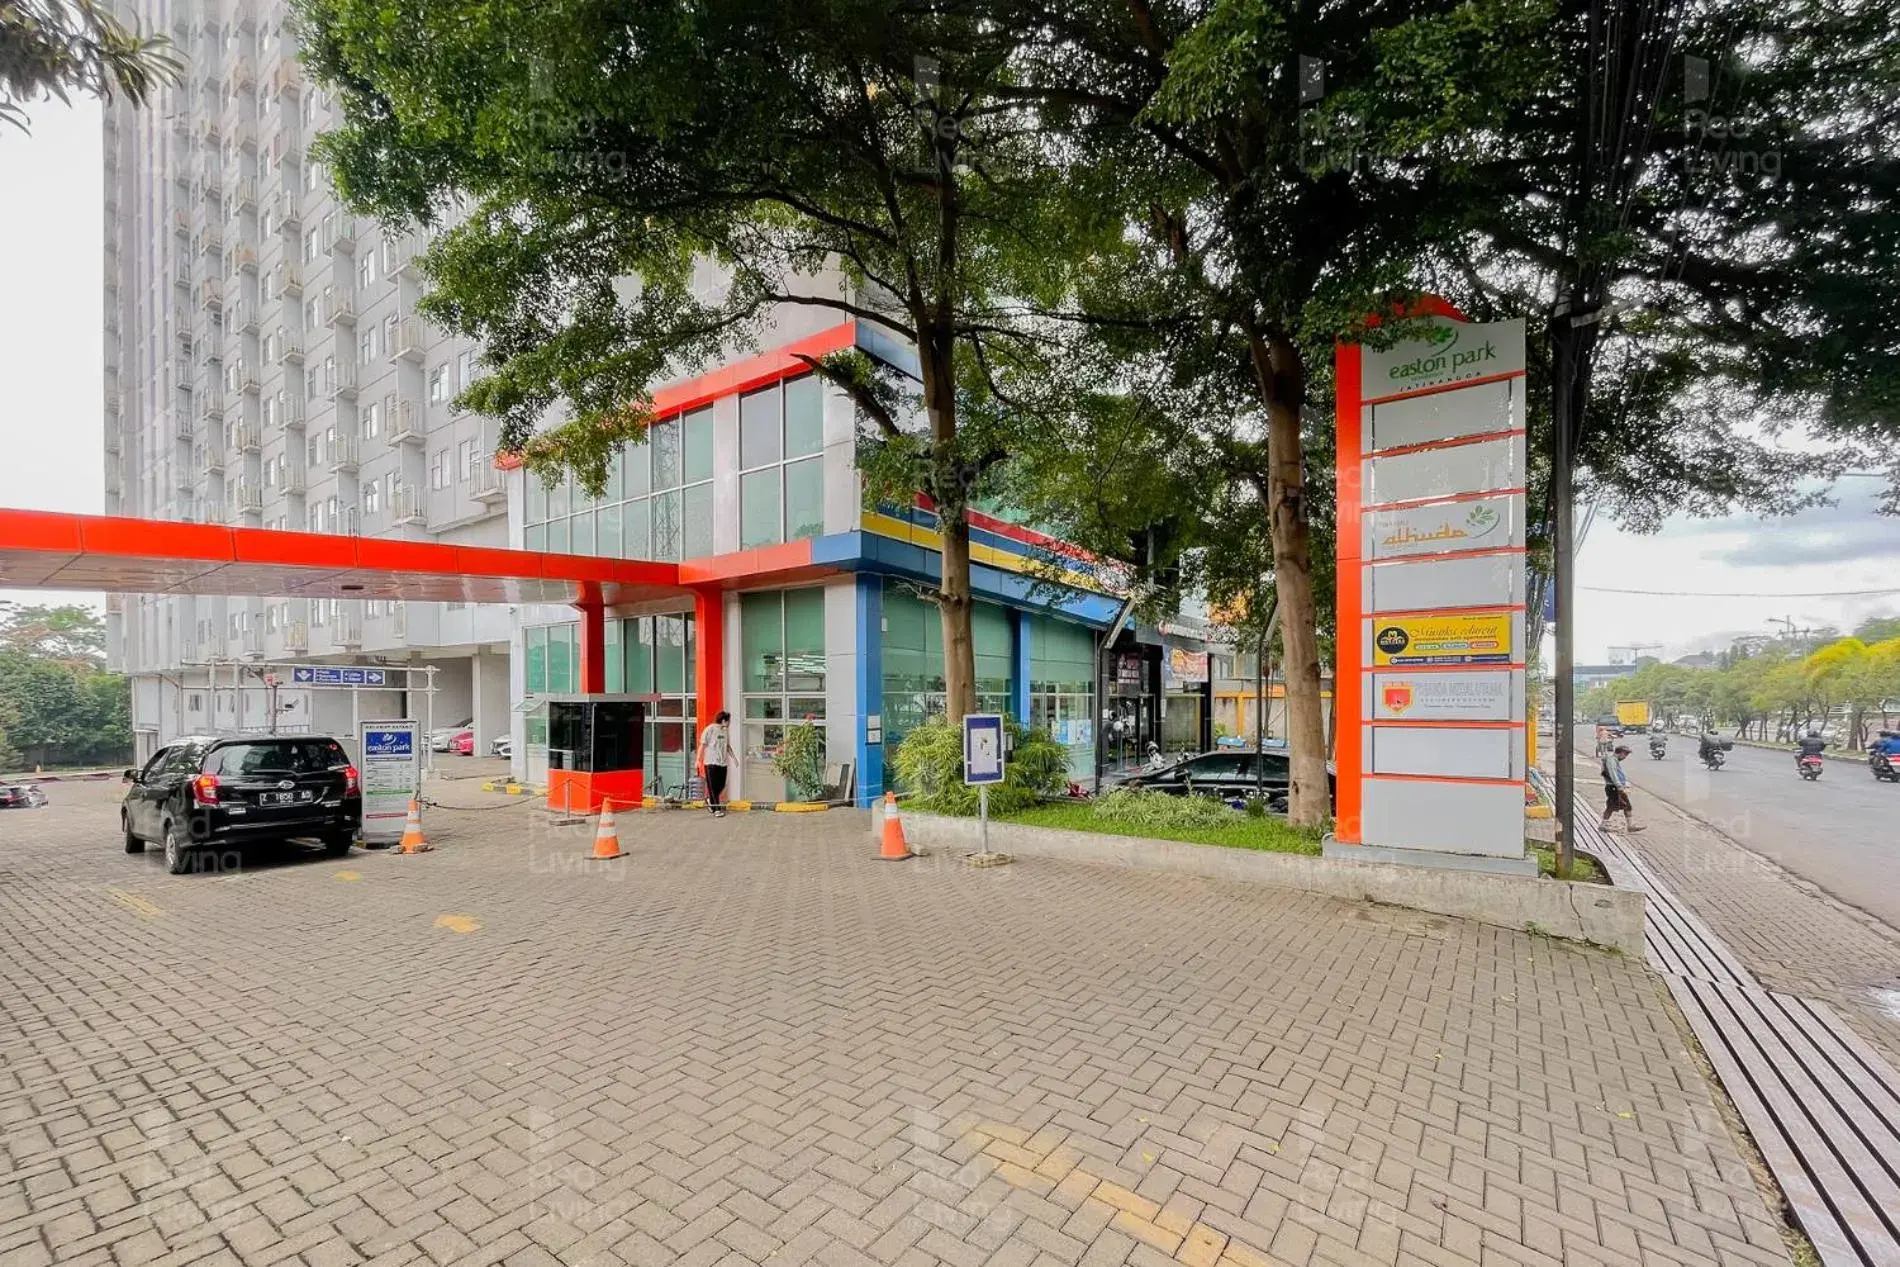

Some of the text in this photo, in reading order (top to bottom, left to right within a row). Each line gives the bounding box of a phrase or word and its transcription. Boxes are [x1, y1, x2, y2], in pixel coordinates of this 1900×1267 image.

[1389, 340, 1496, 379] easton park
[393, 742, 410, 753] park
